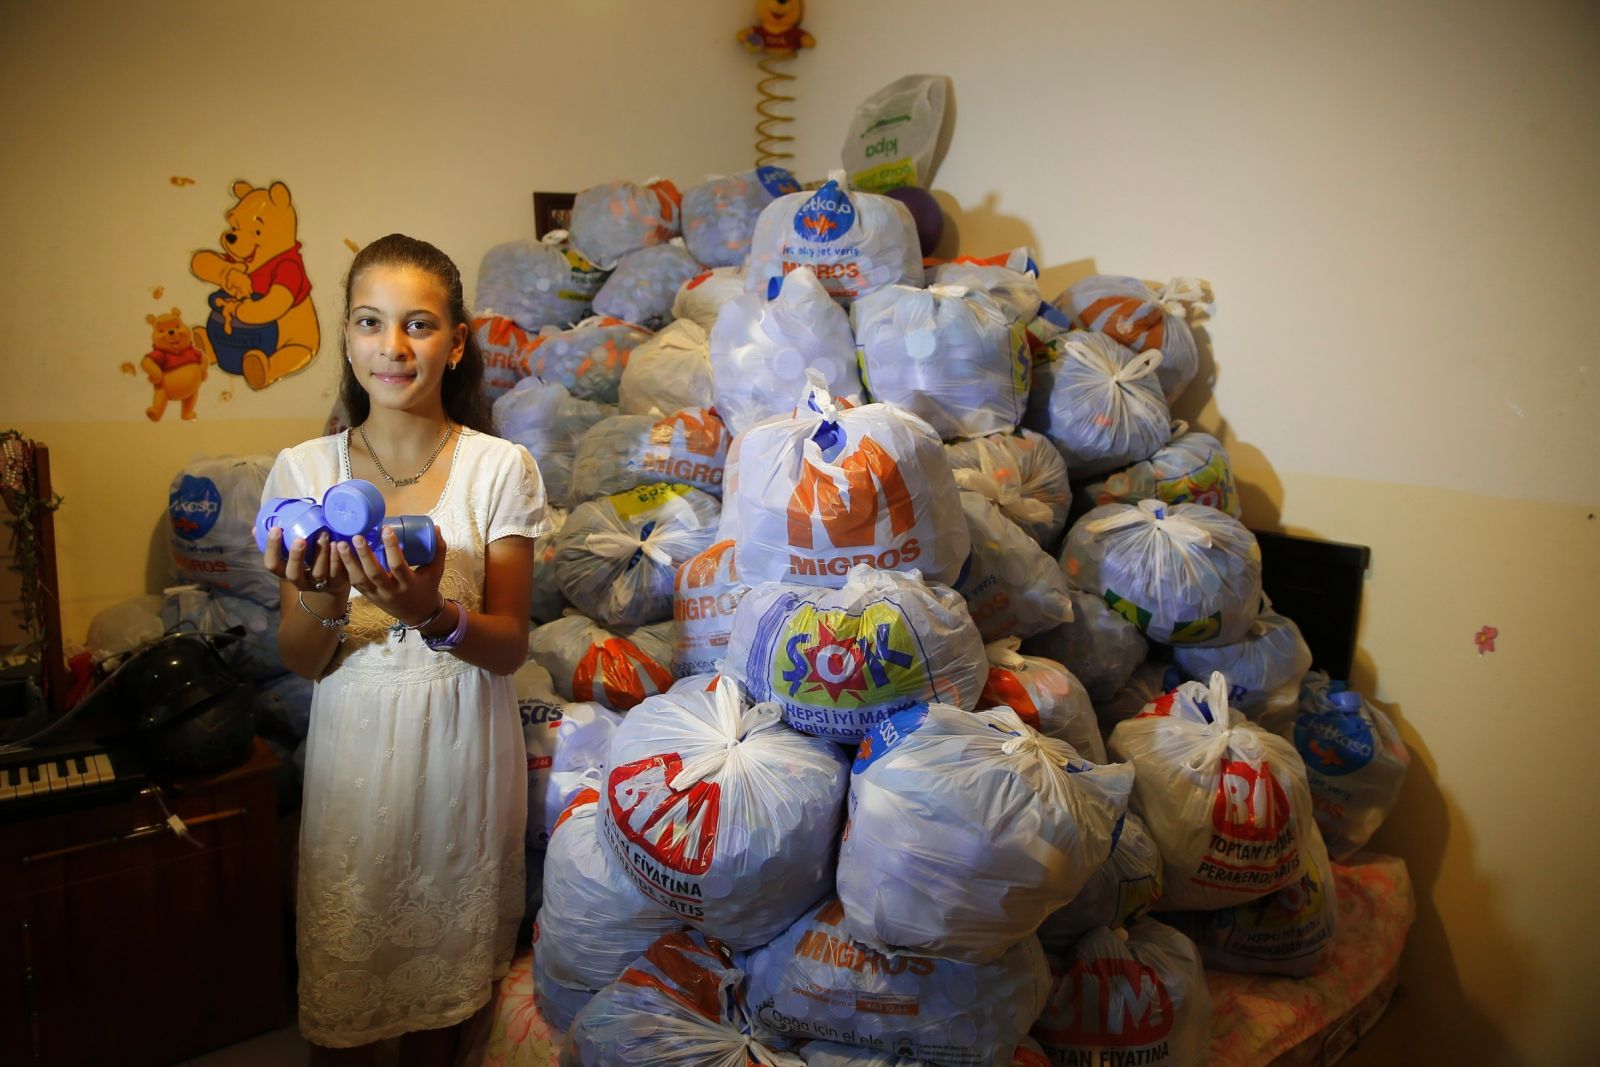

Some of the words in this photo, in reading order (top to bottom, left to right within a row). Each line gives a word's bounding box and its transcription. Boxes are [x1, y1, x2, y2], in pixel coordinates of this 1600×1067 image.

[865, 137, 898, 158] kipa
[783, 261, 860, 279] MROS
[782, 623, 913, 698] ŞOK
[785, 702, 829, 724] HEPSİ
[831, 710, 855, 725] İYİ
[1209, 834, 1262, 861] TOPTAN
[634, 851, 703, 898] FİYATINA
[772, 1009, 809, 1032] Doğa
[812, 1021, 838, 1038] için
[842, 1031, 856, 1043] el
[860, 1036, 884, 1048] ele
